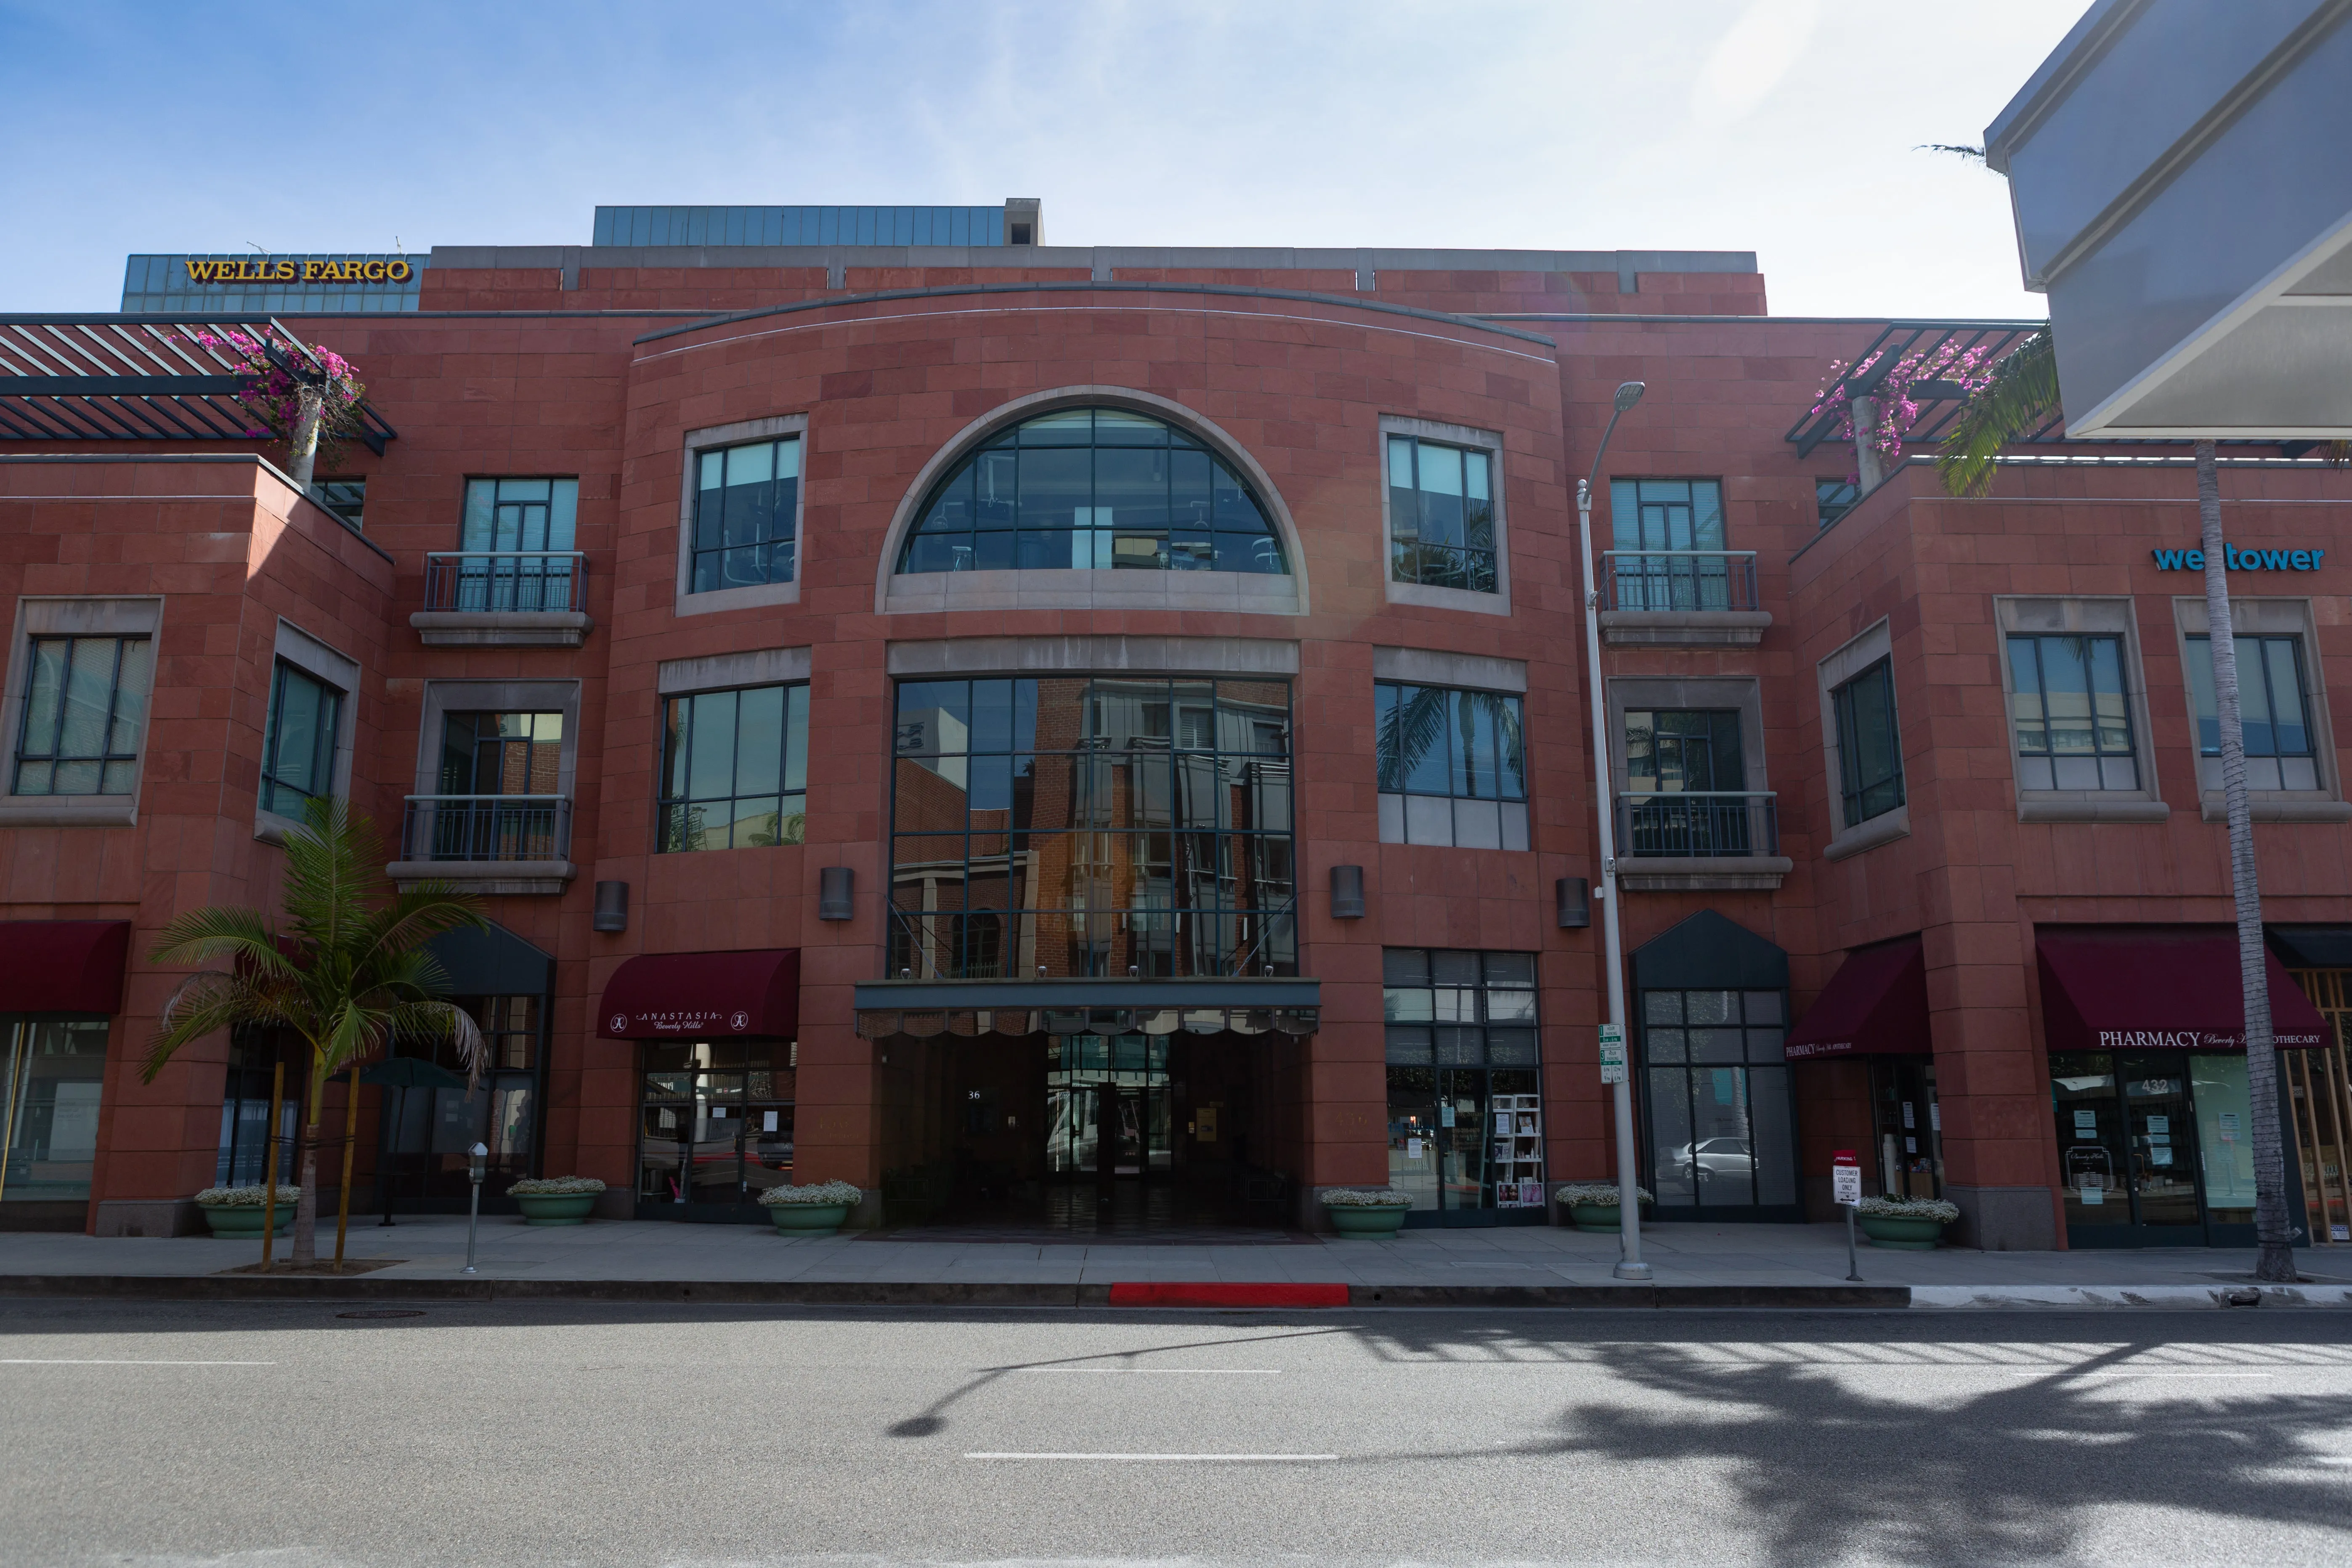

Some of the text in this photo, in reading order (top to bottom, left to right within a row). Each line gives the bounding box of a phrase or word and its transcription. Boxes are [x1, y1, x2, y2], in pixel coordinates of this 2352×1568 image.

[186, 260, 411, 282] WELLS FARGO
[2152, 542, 2325, 571] wetower
[654, 1021, 682, 1032] Beverly
[2099, 1031, 2201, 1046] PHARMACY
[2203, 1033, 2235, 1047] Beverly
[1601, 1051, 1604, 1060] 3
[1786, 1043, 1815, 1057] PHARMACY
[2142, 1079, 2168, 1092] 432
[968, 1090, 980, 1099] 36
